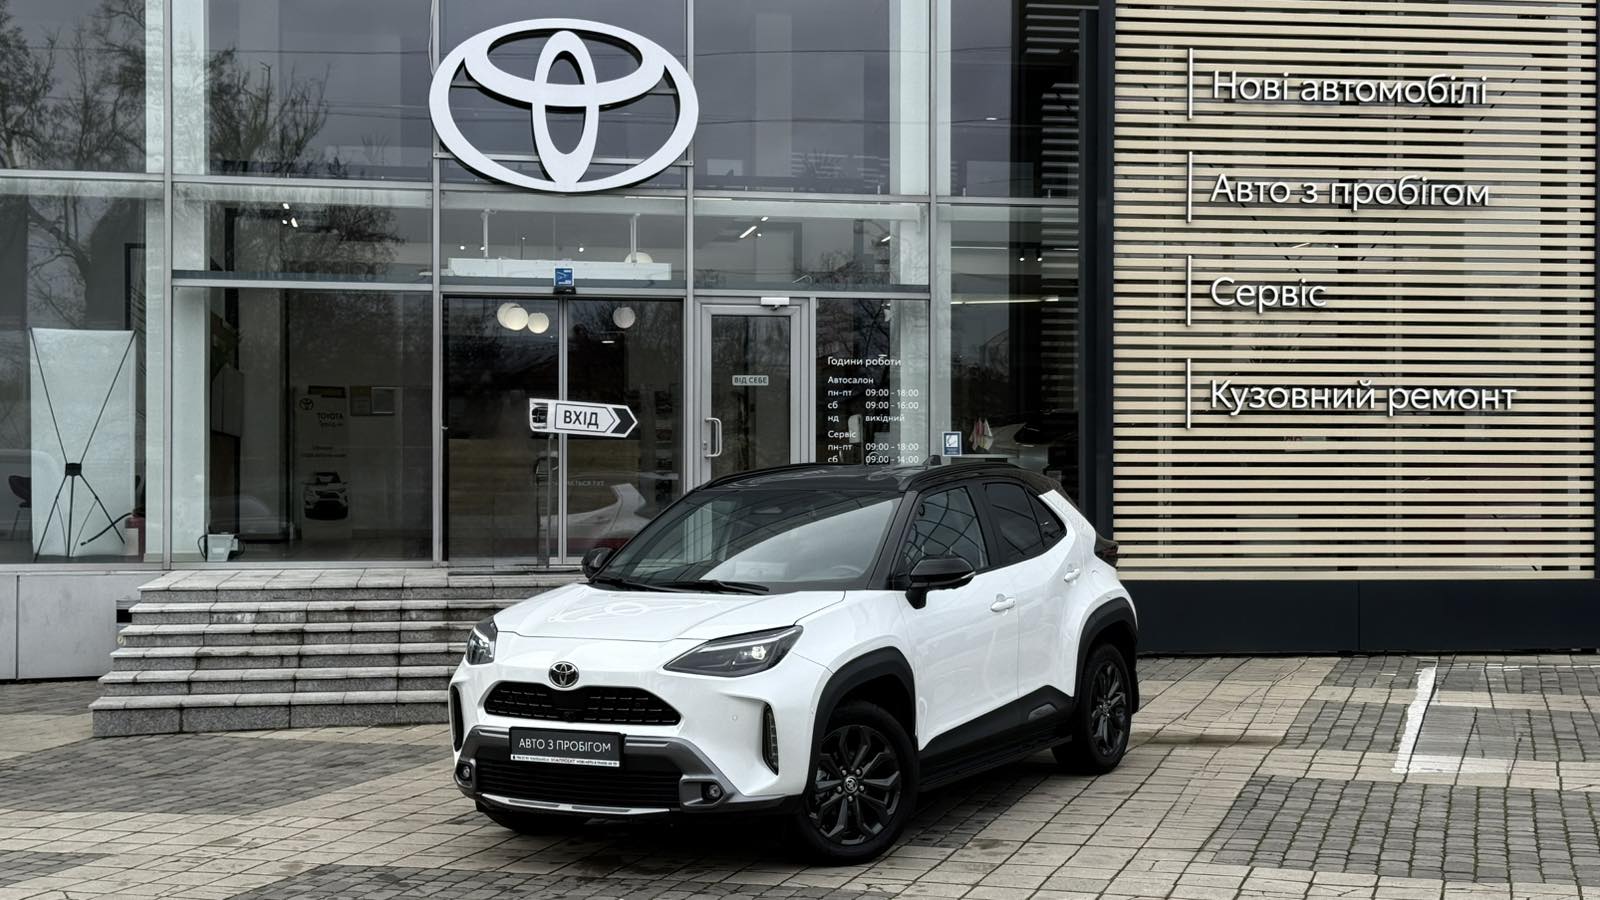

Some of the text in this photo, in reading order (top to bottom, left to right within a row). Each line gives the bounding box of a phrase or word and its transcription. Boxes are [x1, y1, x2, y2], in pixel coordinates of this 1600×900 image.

[1211, 70, 1488, 105] Нові автомобілі
[1210, 173, 1490, 212] Авто з пробігом
[1210, 277, 1327, 314] Сервіс
[827, 356, 902, 367] Години роботи
[734, 376, 768, 385] ВІД СЕБЕ
[827, 376, 874, 384] Автосалон
[827, 389, 852, 397] пн-пт
[865, 388, 889, 397] 09:00
[1210, 379, 1518, 417] Кузовний ремонт
[827, 401, 839, 409] сб
[865, 401, 889, 409] 09:00
[563, 408, 599, 430] ВХІД
[865, 414, 905, 422] вихідний
[827, 430, 857, 439] Сервіс
[865, 442, 889, 451] 09:00
[827, 455, 839, 463] сб
[865, 455, 889, 464] 09:00
[518, 738, 611, 753] АВТО З ПРОБІГОМ
